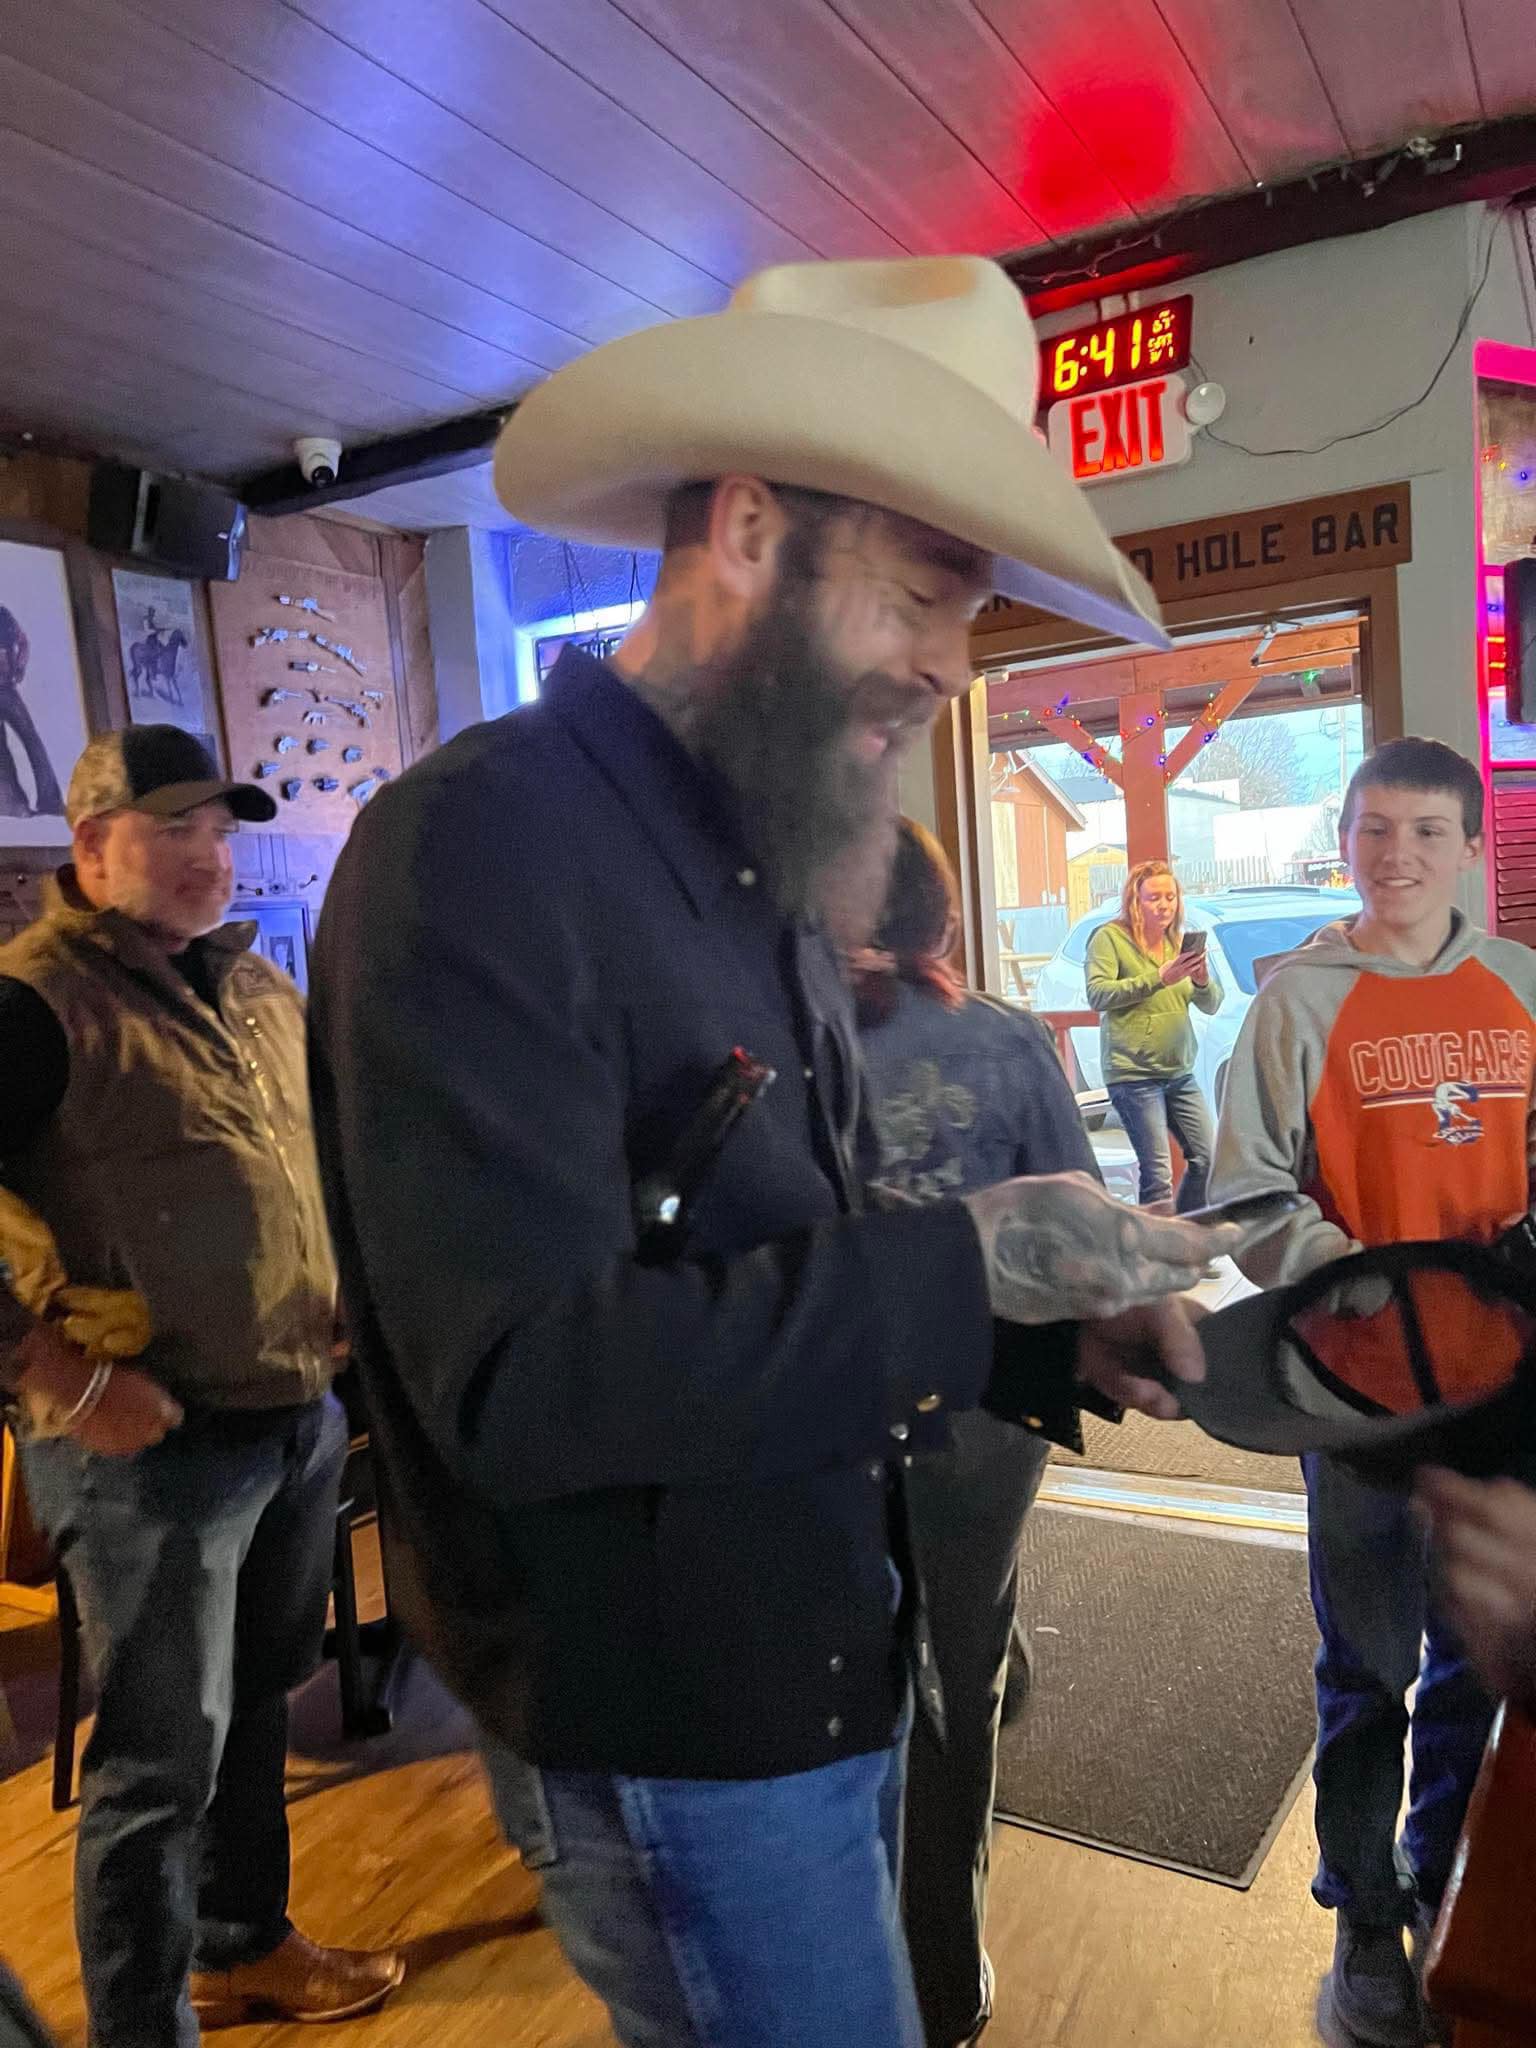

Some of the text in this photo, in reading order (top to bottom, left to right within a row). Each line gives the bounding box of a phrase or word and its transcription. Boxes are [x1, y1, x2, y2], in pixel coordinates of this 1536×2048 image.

[1054, 318, 1142, 393] 6:41
[1069, 380, 1167, 479] EXIT
[1177, 522, 1285, 581] HOLE
[1312, 502, 1399, 556] BAR
